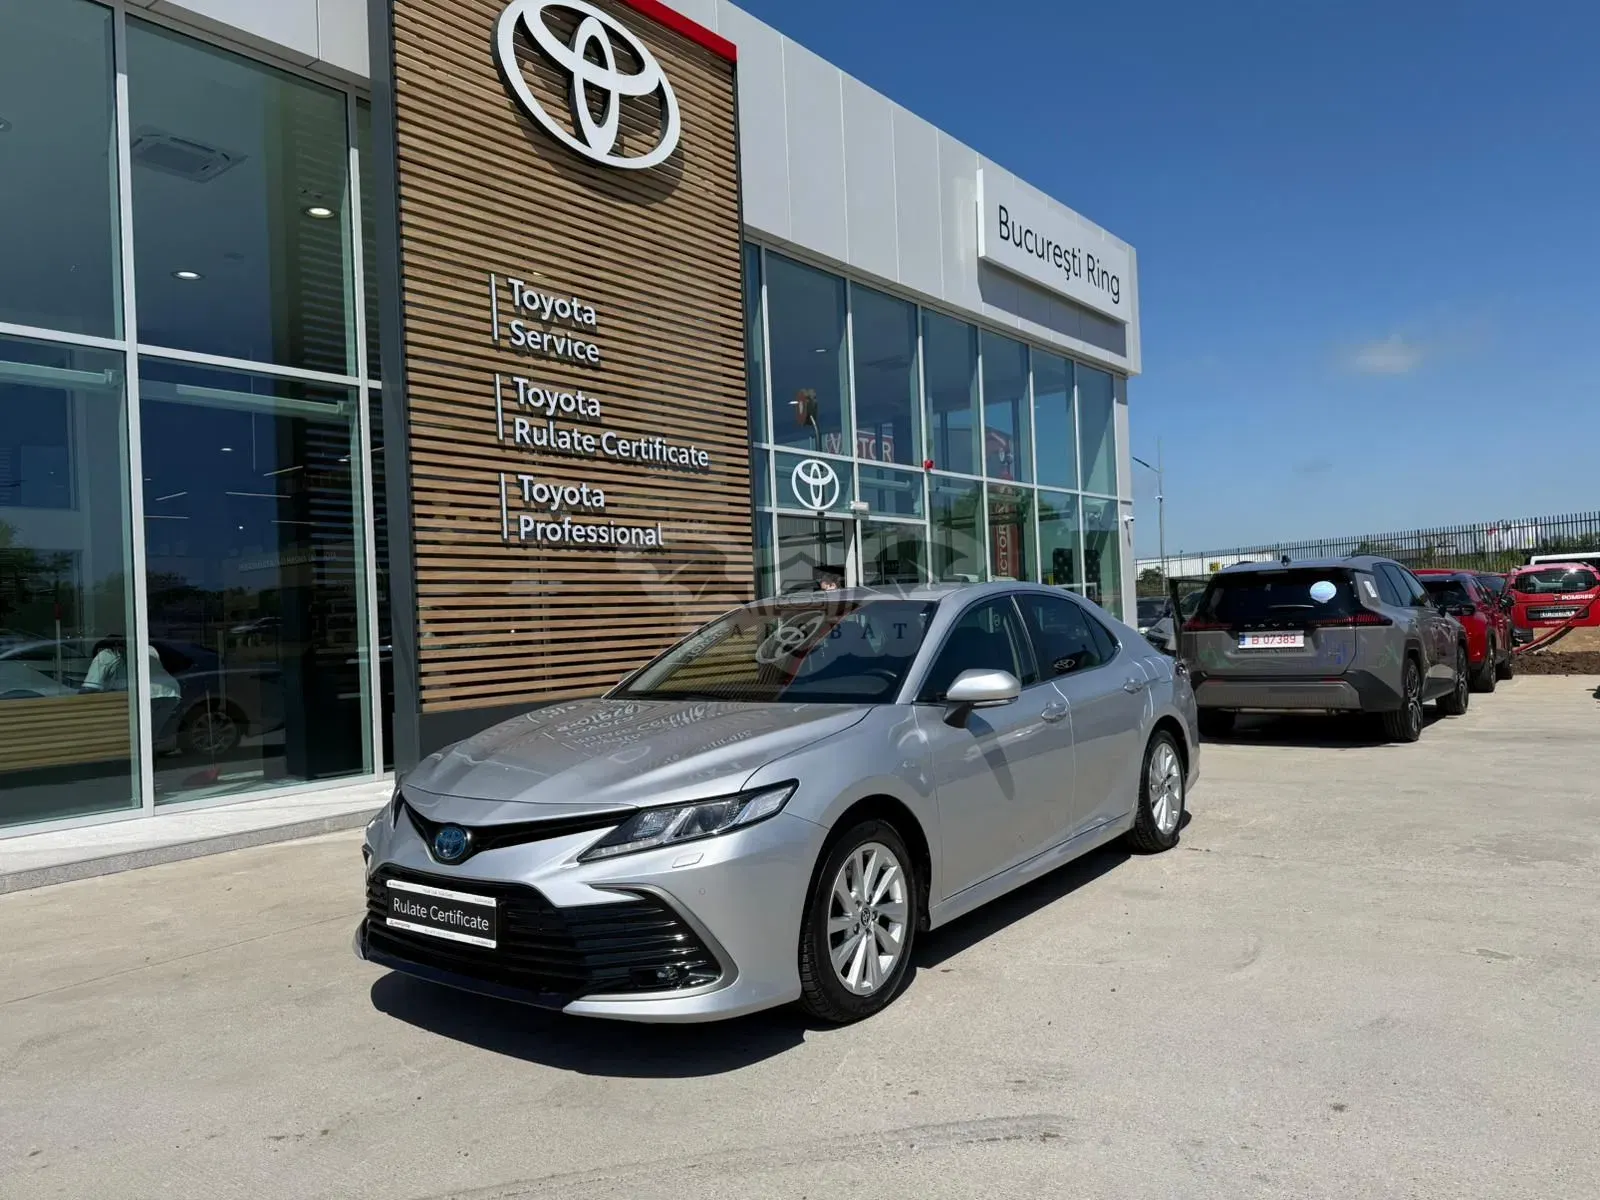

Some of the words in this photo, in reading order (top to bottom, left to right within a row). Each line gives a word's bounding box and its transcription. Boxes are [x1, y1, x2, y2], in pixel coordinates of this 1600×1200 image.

[1087, 253, 1120, 305] Ring
[508, 277, 596, 325] Toyota
[510, 318, 601, 363] Service
[513, 376, 601, 417] Toyota
[515, 417, 597, 452] Rulate
[601, 431, 710, 467] Certificate
[518, 474, 606, 511] Toyota
[519, 514, 665, 546] Professional
[1251, 635, 1260, 645] B
[1263, 633, 1296, 645] 07389
[393, 897, 428, 919] Rulate
[429, 905, 489, 931] Certificate
